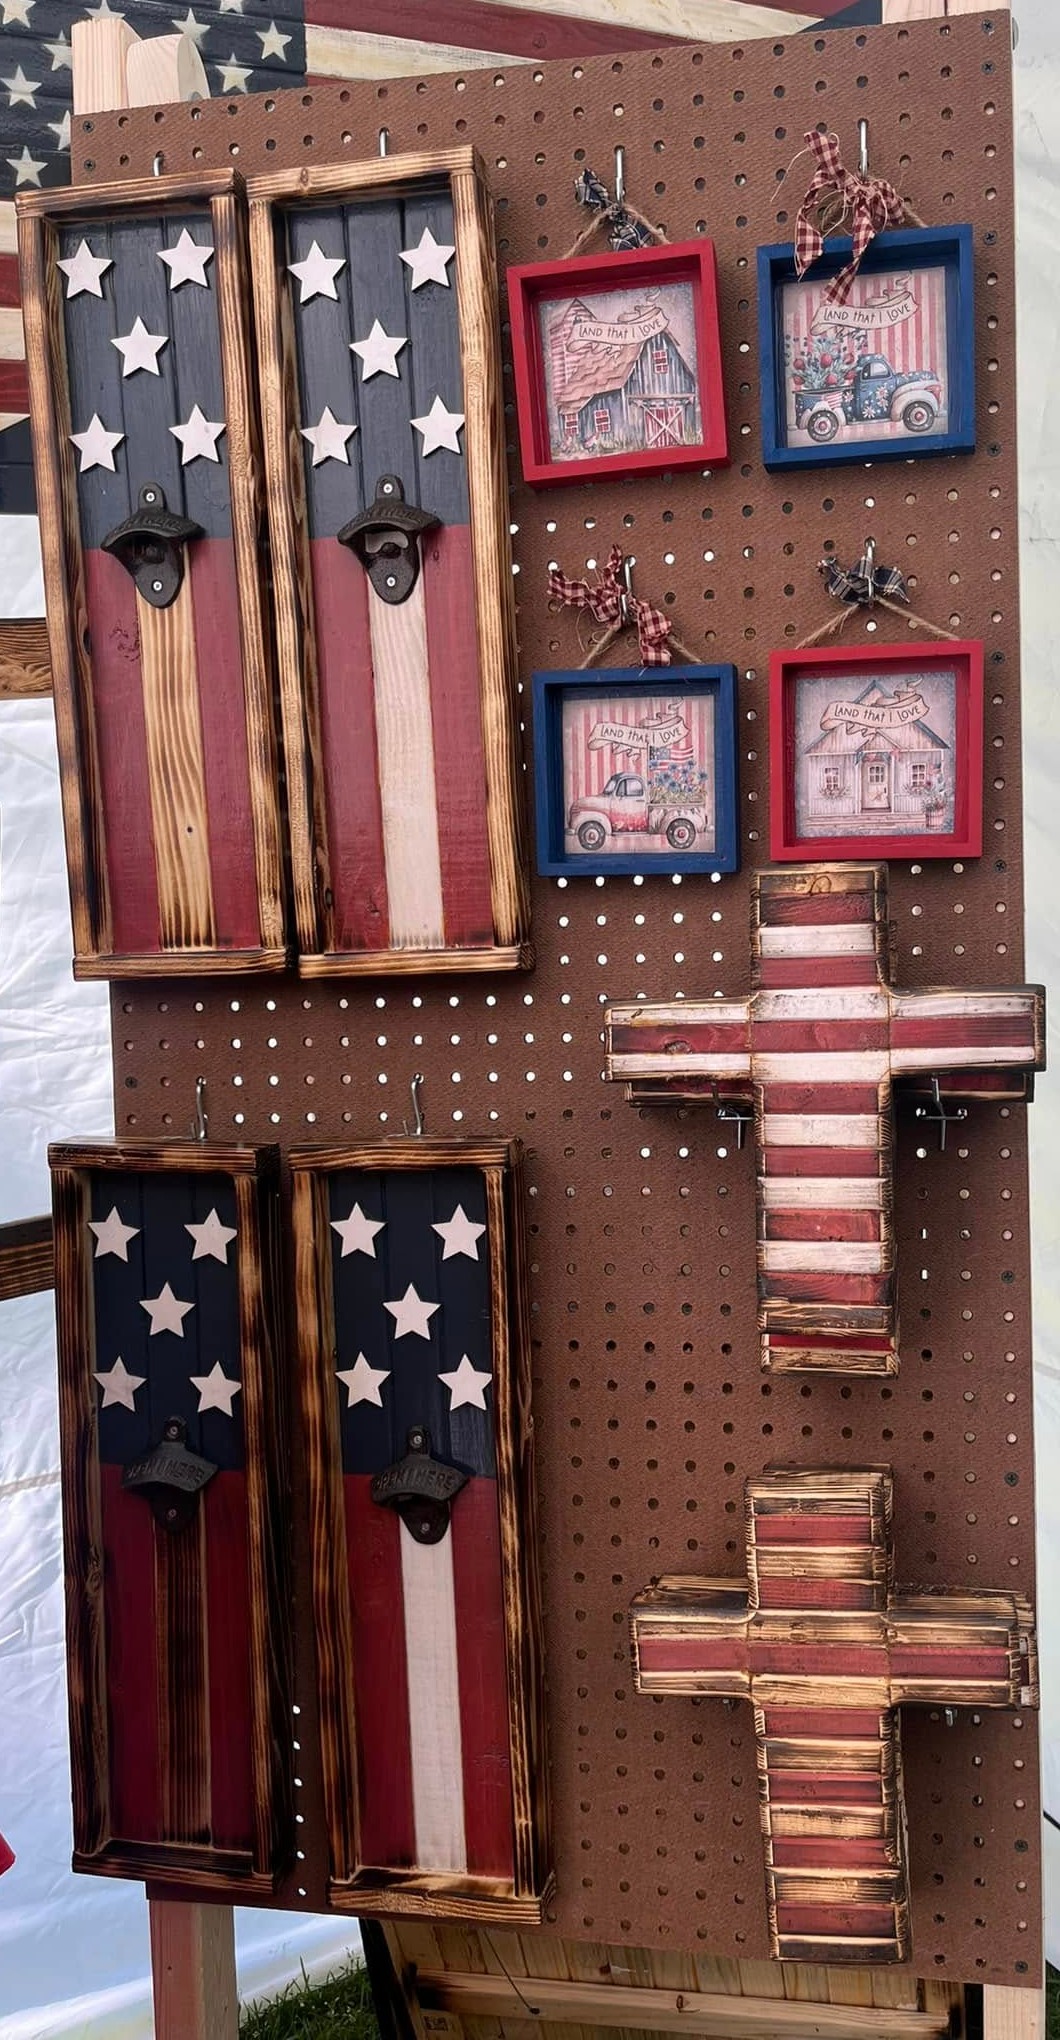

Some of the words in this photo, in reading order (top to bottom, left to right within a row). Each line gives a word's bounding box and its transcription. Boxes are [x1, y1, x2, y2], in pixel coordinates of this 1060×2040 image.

[824, 308, 849, 321] LAND
[887, 303, 911, 322] LOVE
[579, 325, 603, 337] LAND
[639, 319, 662, 337] LOVE
[835, 704, 860, 717] LAND
[897, 705, 921, 721] LOVE
[600, 725, 625, 738] LAND
[660, 727, 681, 743] LOVE
